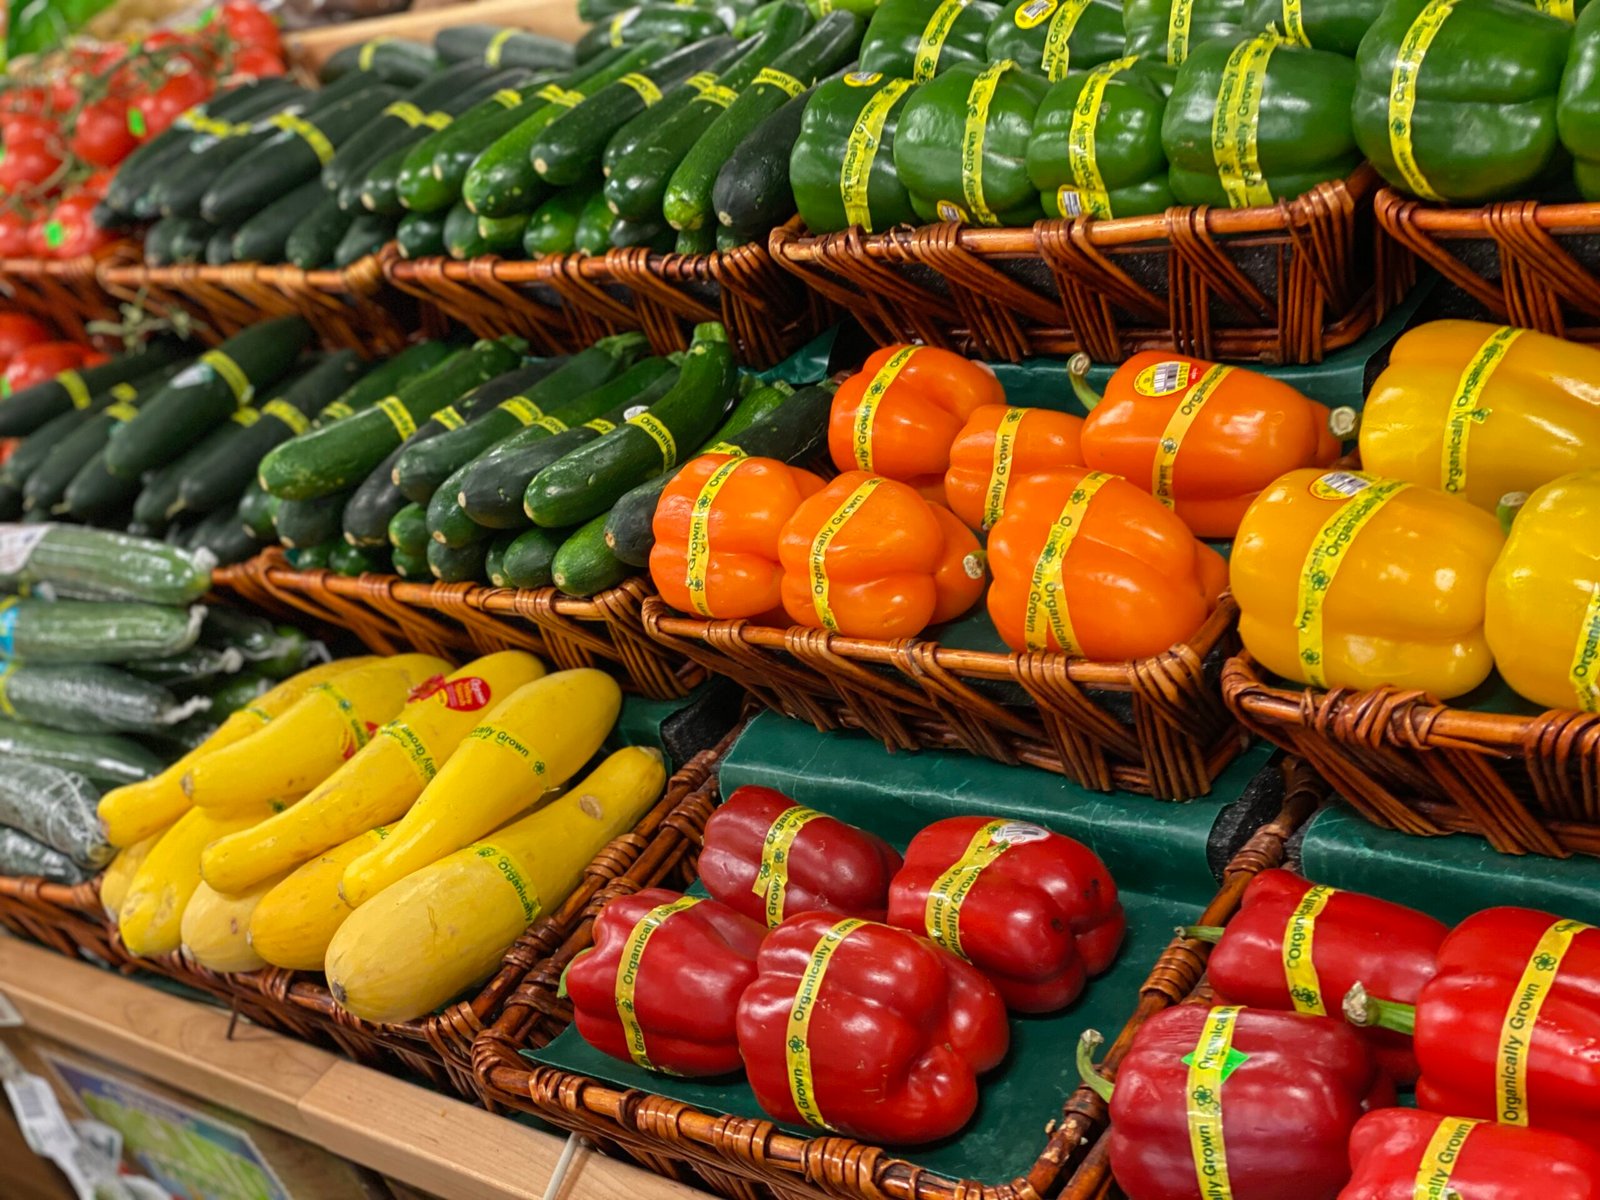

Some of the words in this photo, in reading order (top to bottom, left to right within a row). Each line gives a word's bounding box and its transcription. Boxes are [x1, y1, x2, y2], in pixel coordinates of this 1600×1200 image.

[964, 131, 976, 171] Grown
[996, 434, 1010, 475] Grown
[814, 526, 834, 594] Organically
[832, 494, 863, 525] Grown
[1027, 592, 1041, 632] Grown
[497, 731, 529, 757] Grown
[498, 861, 533, 921] Organically
[768, 875, 781, 915] Grown
[952, 867, 982, 903] Grown
[794, 942, 831, 1021] Organically
[1509, 983, 1540, 1030] Grown
[794, 1069, 809, 1109] Grown
[1503, 1036, 1523, 1121] Organically
[1200, 1125, 1216, 1176] Grown
[1438, 1123, 1471, 1164] Grown
